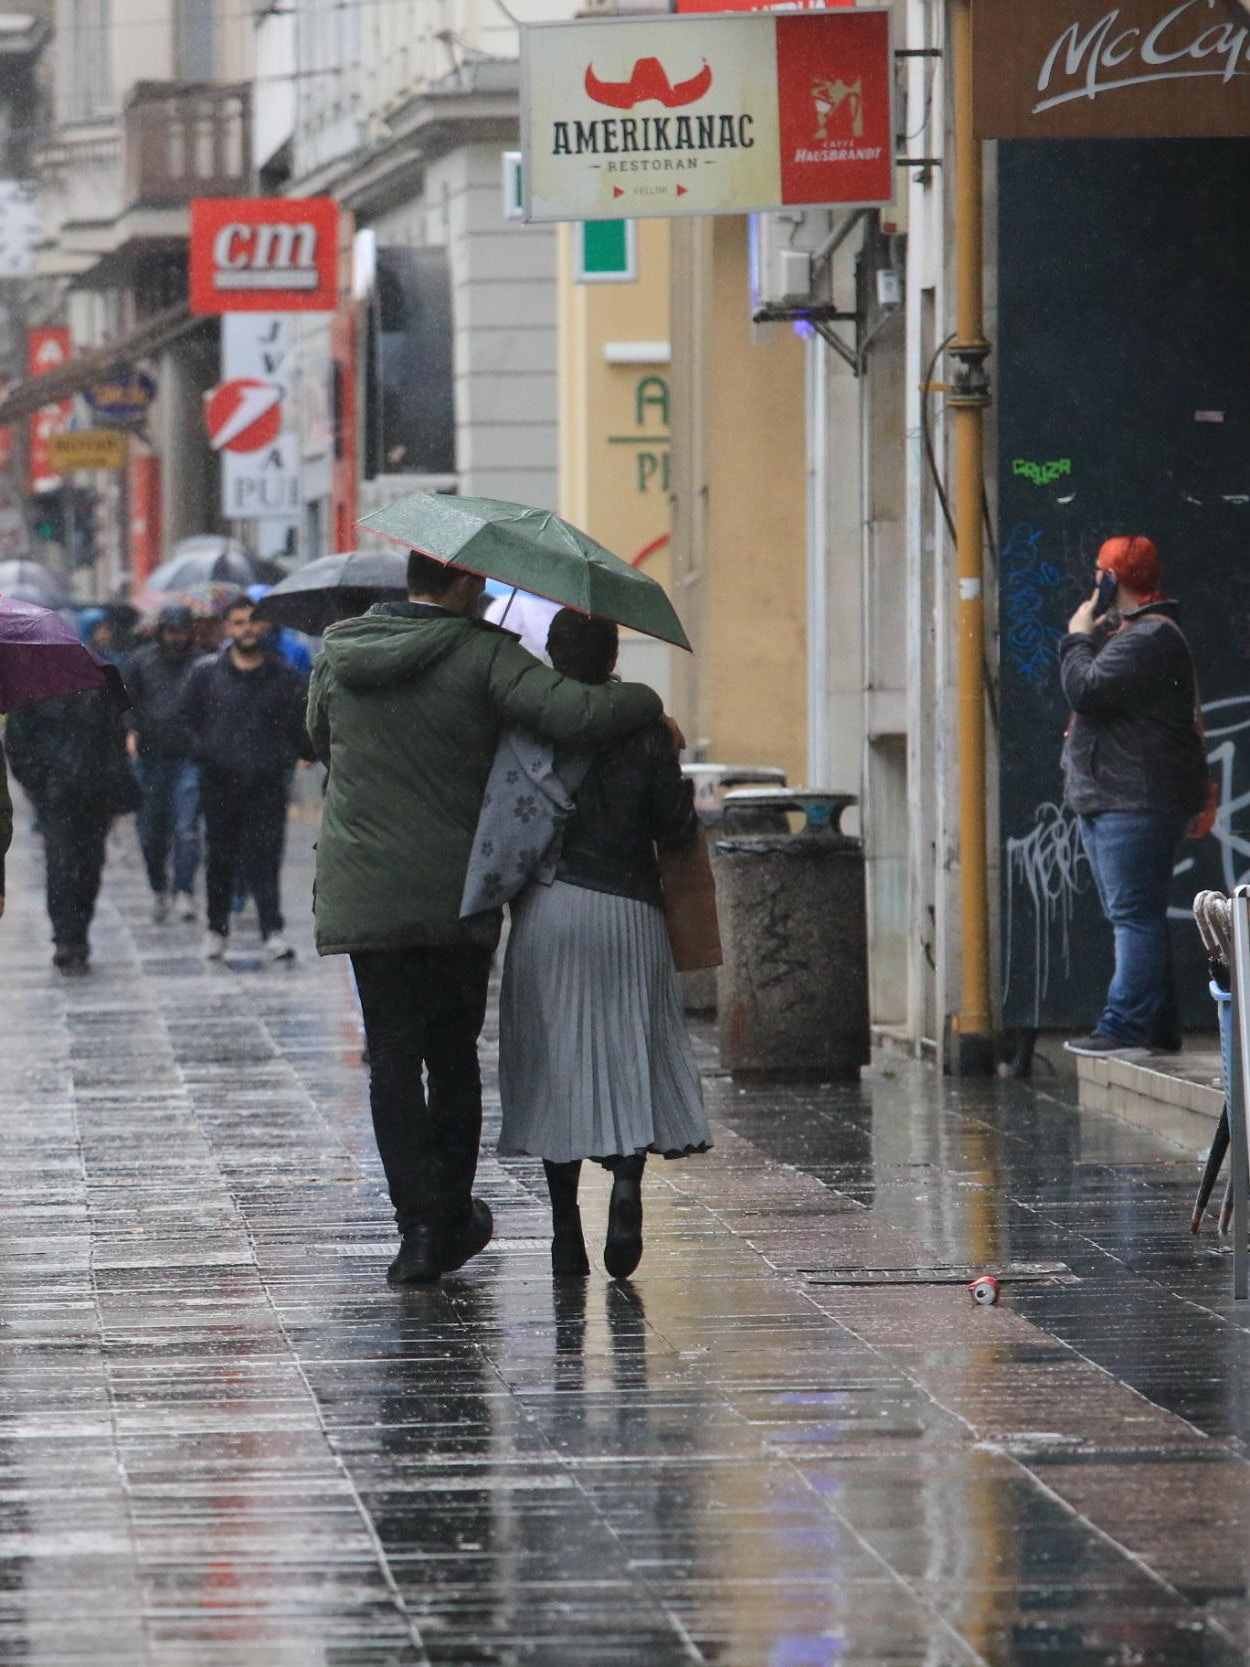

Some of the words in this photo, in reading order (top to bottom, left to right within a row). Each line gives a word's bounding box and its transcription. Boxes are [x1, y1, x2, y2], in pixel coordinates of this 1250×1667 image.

[552, 113, 754, 155] AMERIKANAC
[607, 158, 698, 172] RESTORAN
[794, 146, 882, 162] HAUSBRANDT
[213, 221, 318, 271] cm
